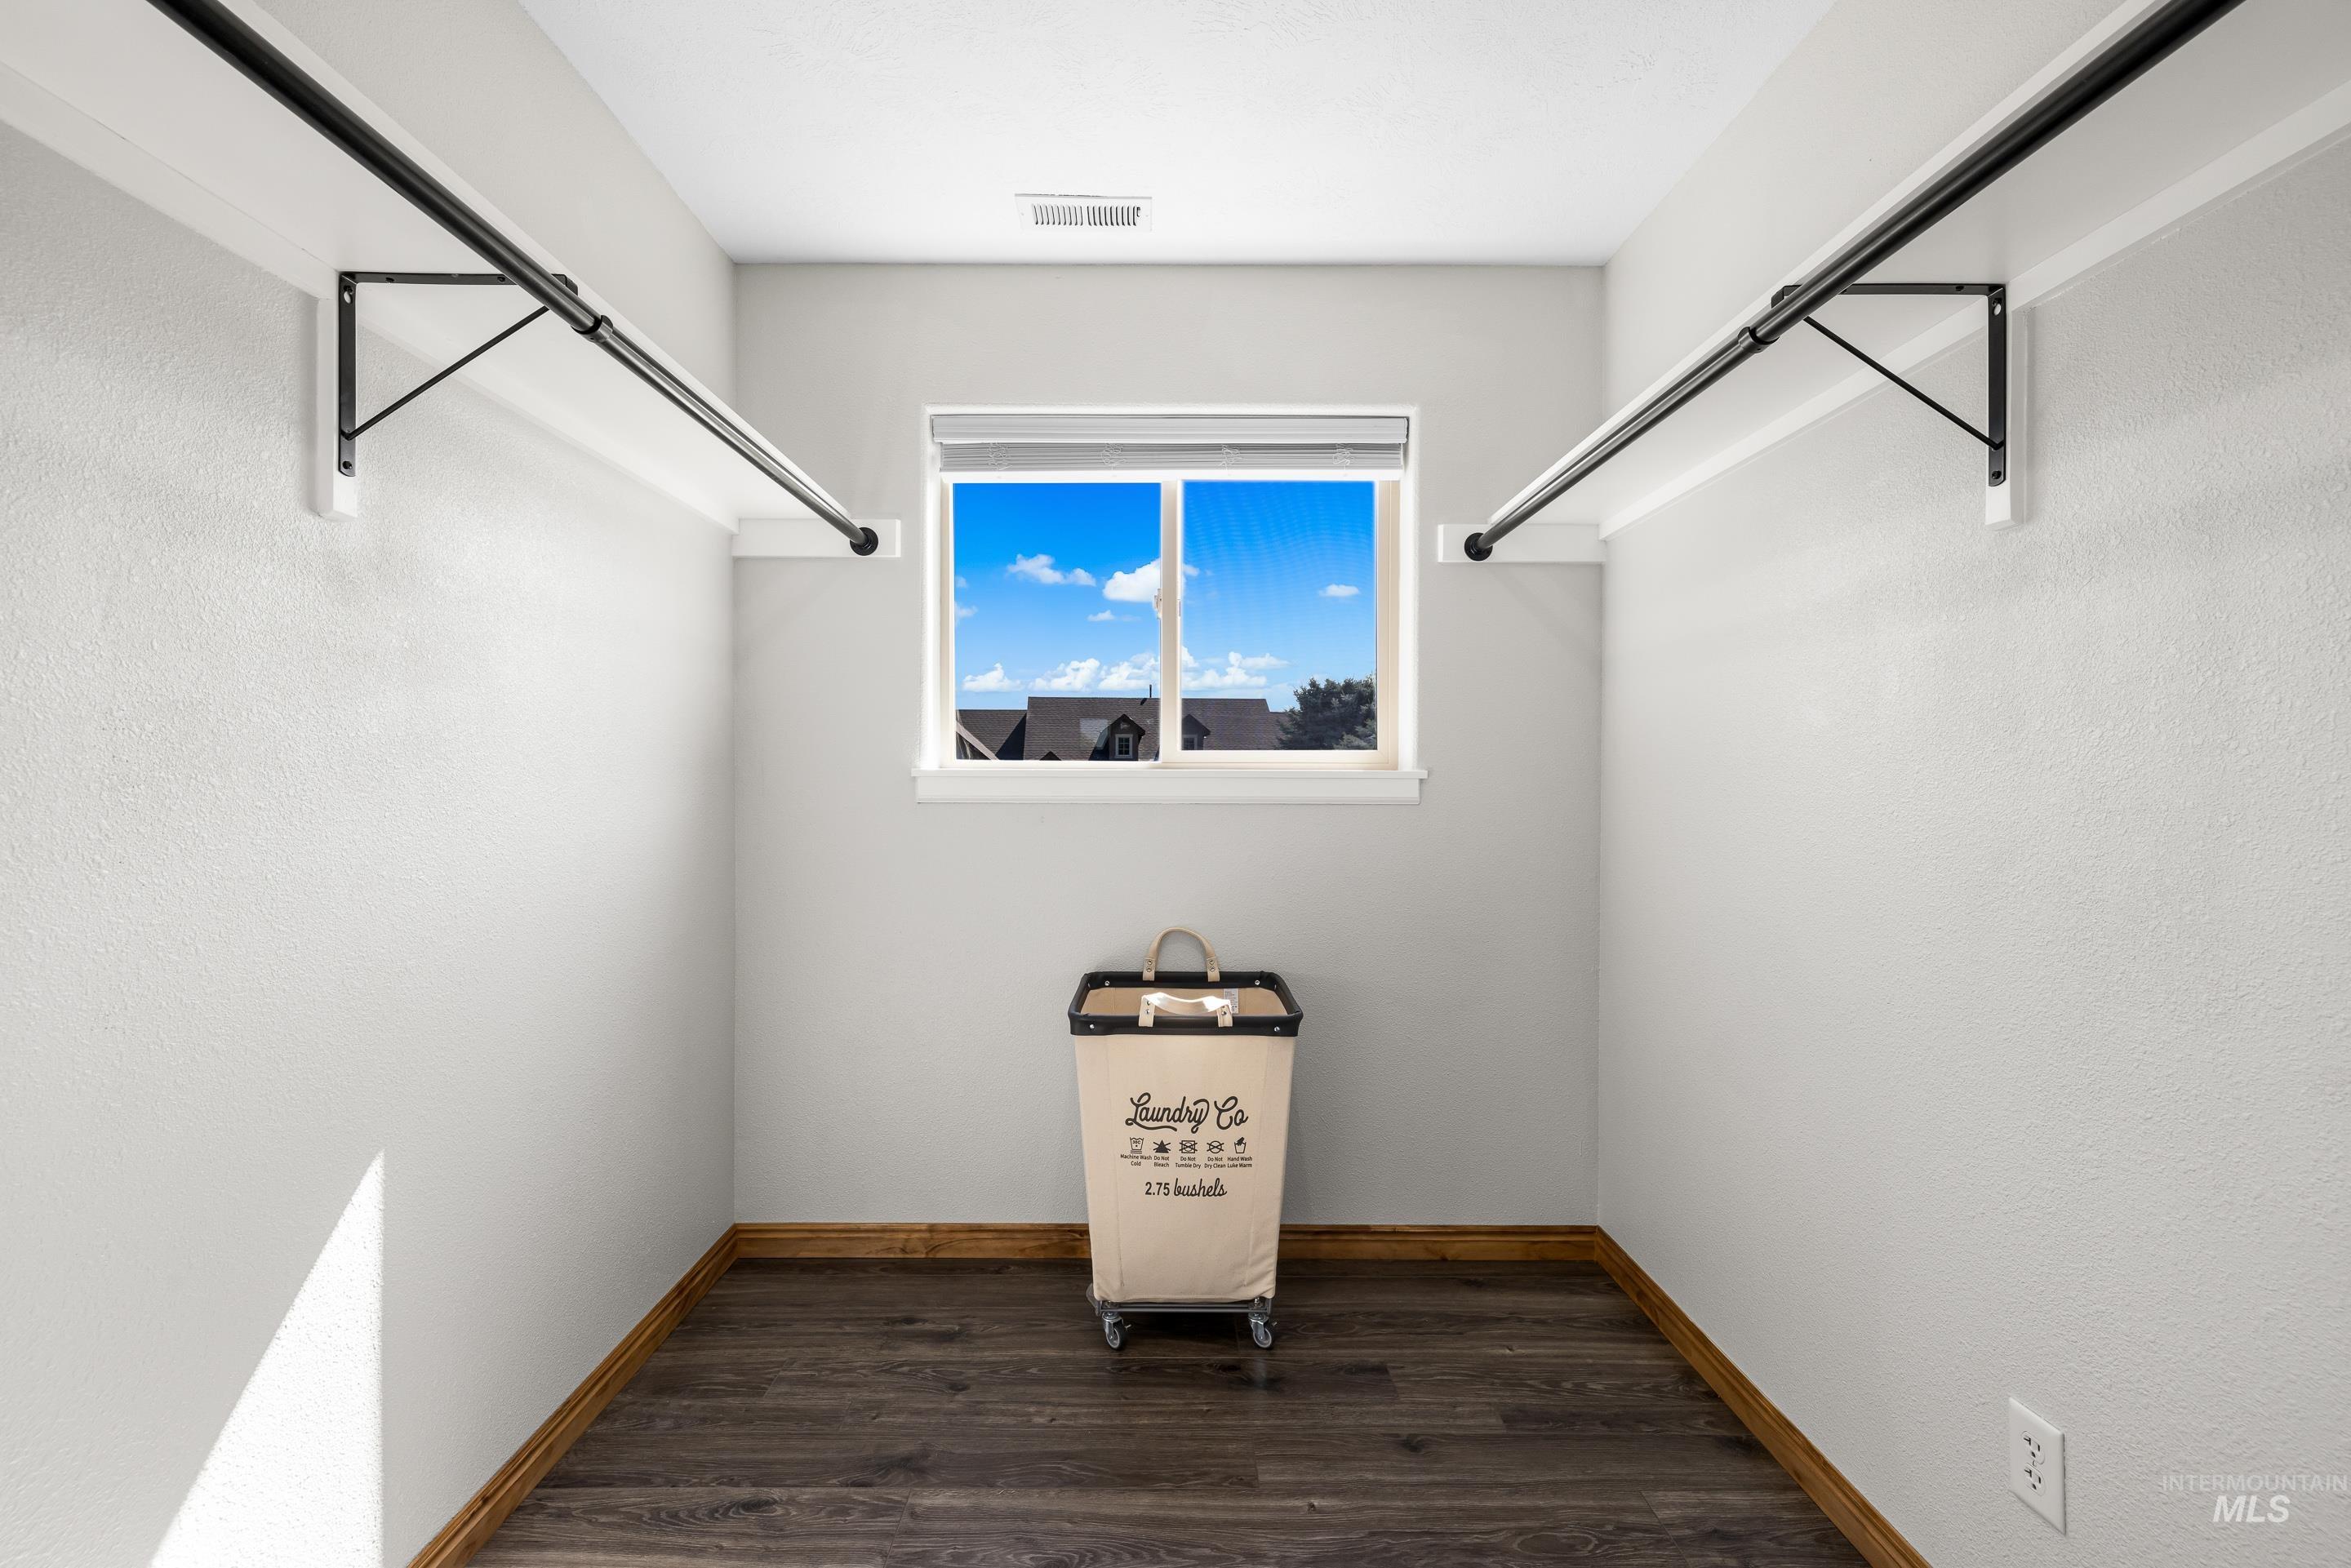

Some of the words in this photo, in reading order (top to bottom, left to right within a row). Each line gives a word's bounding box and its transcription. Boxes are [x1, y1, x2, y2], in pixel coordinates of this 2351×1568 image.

[1125, 1092, 1210, 1134] Laundry
[1214, 1096, 1248, 1130] Co
[1145, 1182, 1170, 1196] 2.75
[1174, 1178, 1227, 1197] bushels
